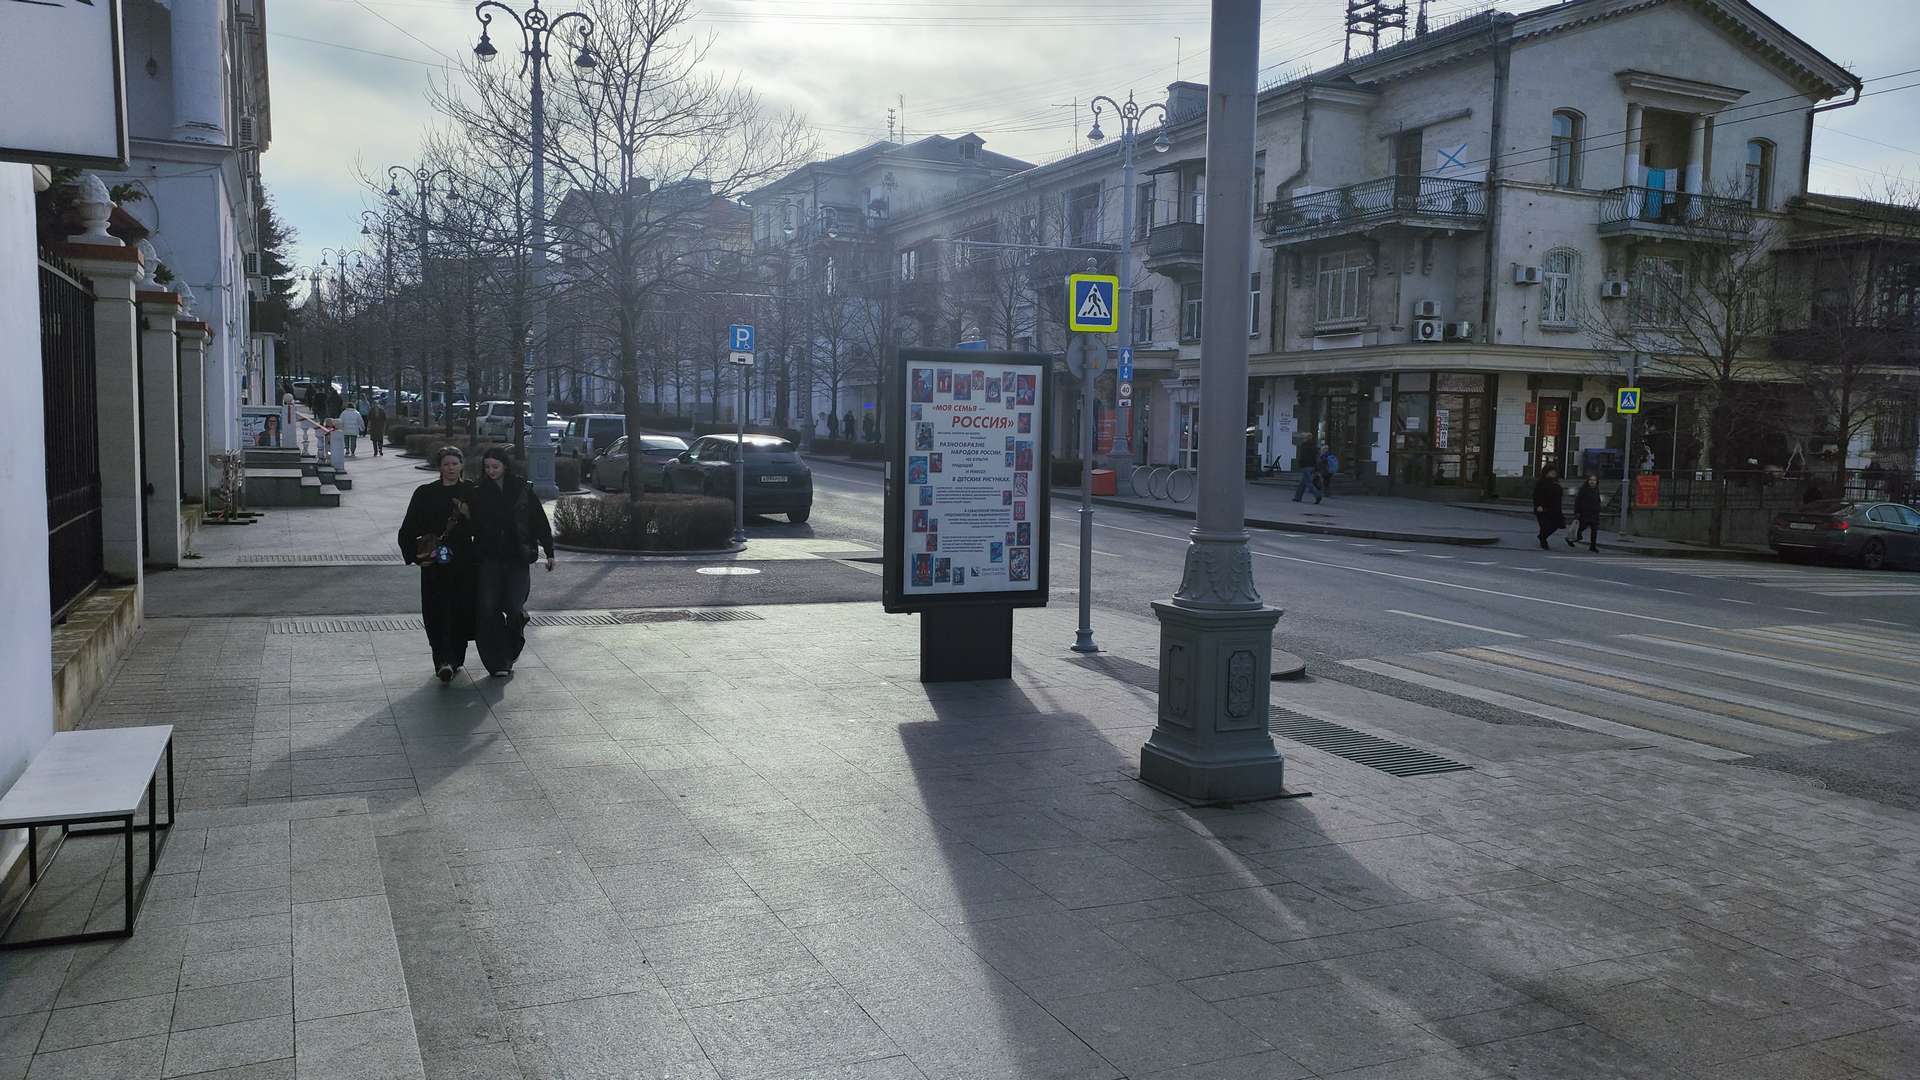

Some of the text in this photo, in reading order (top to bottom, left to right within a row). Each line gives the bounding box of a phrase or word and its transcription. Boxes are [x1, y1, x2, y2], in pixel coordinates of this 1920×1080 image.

[736, 328, 750, 348] P
[954, 404, 977, 412] СЕМЬЯ
[951, 416, 1014, 429] РОССИЯ»
